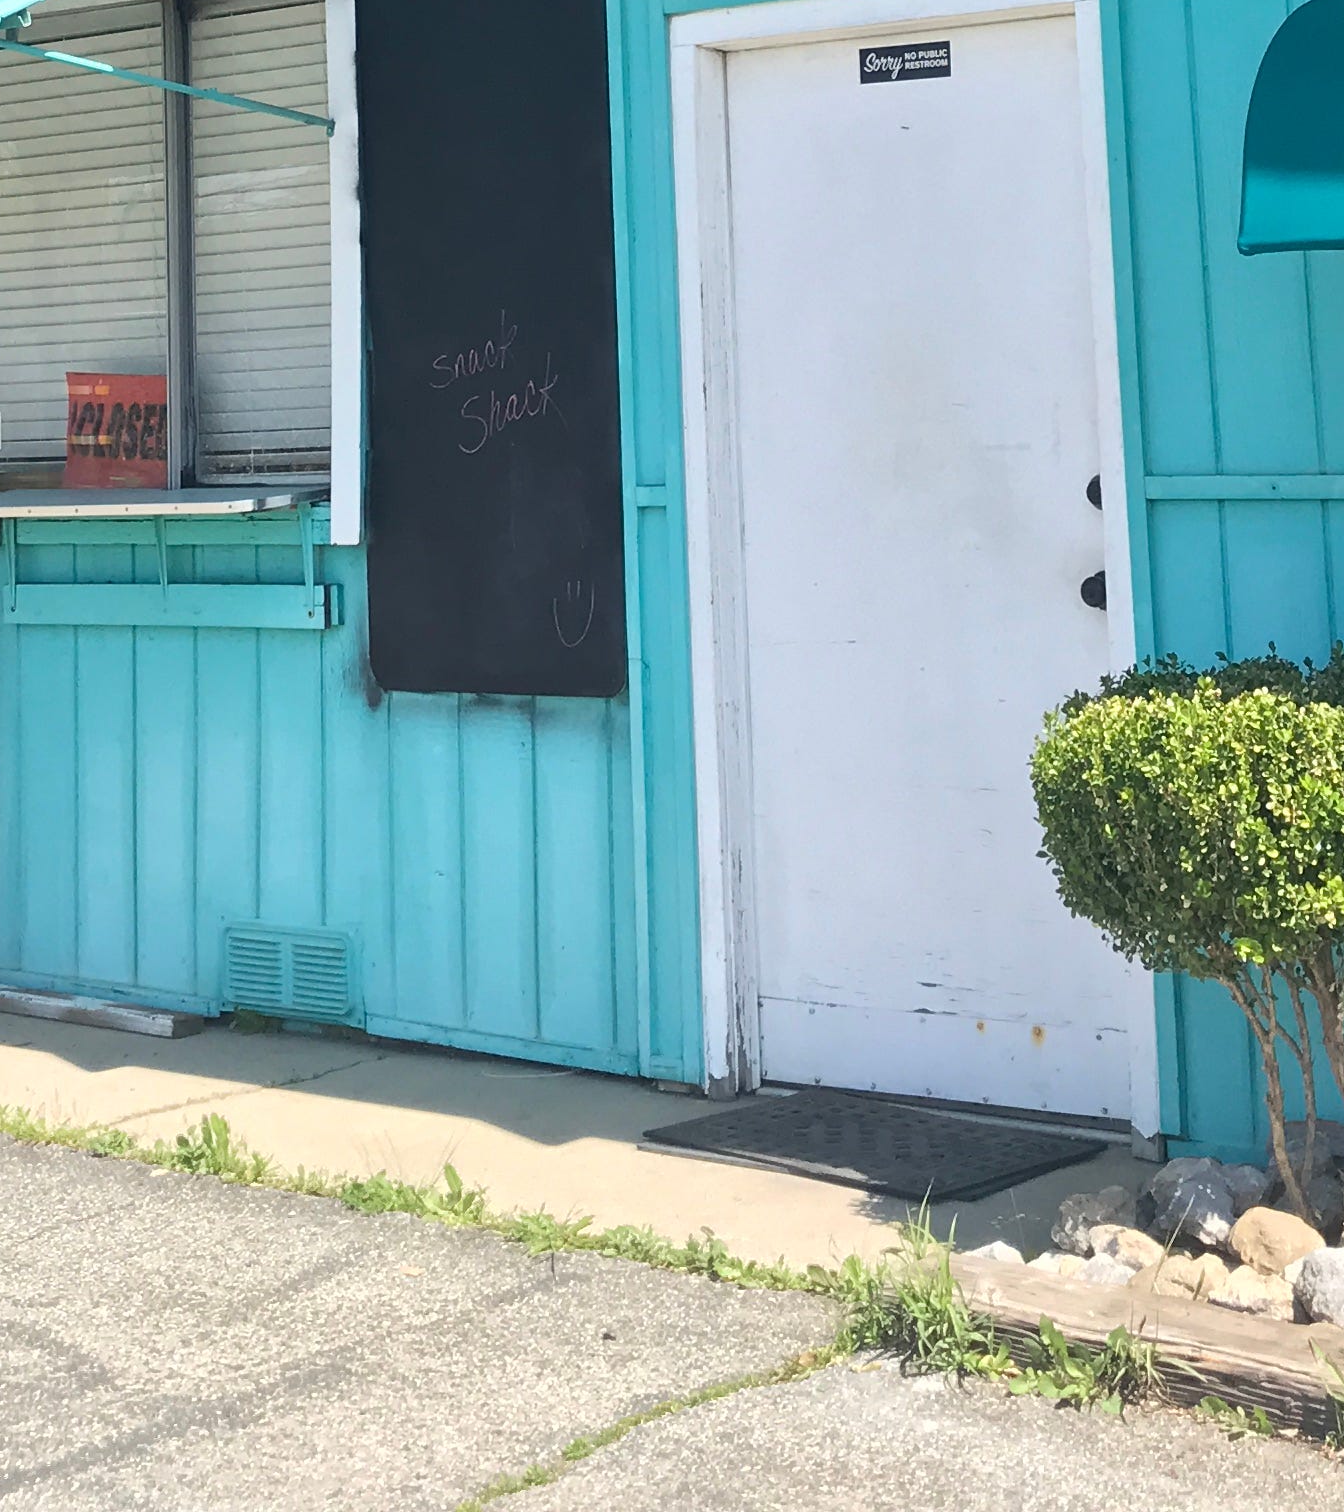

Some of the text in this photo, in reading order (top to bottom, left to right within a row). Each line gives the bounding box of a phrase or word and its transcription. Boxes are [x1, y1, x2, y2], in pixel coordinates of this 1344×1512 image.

[904, 48, 948, 61] NO PUBLIC
[904, 58, 949, 70] RESTROOM
[863, 52, 904, 80] Sorry
[458, 351, 567, 455] Shack
